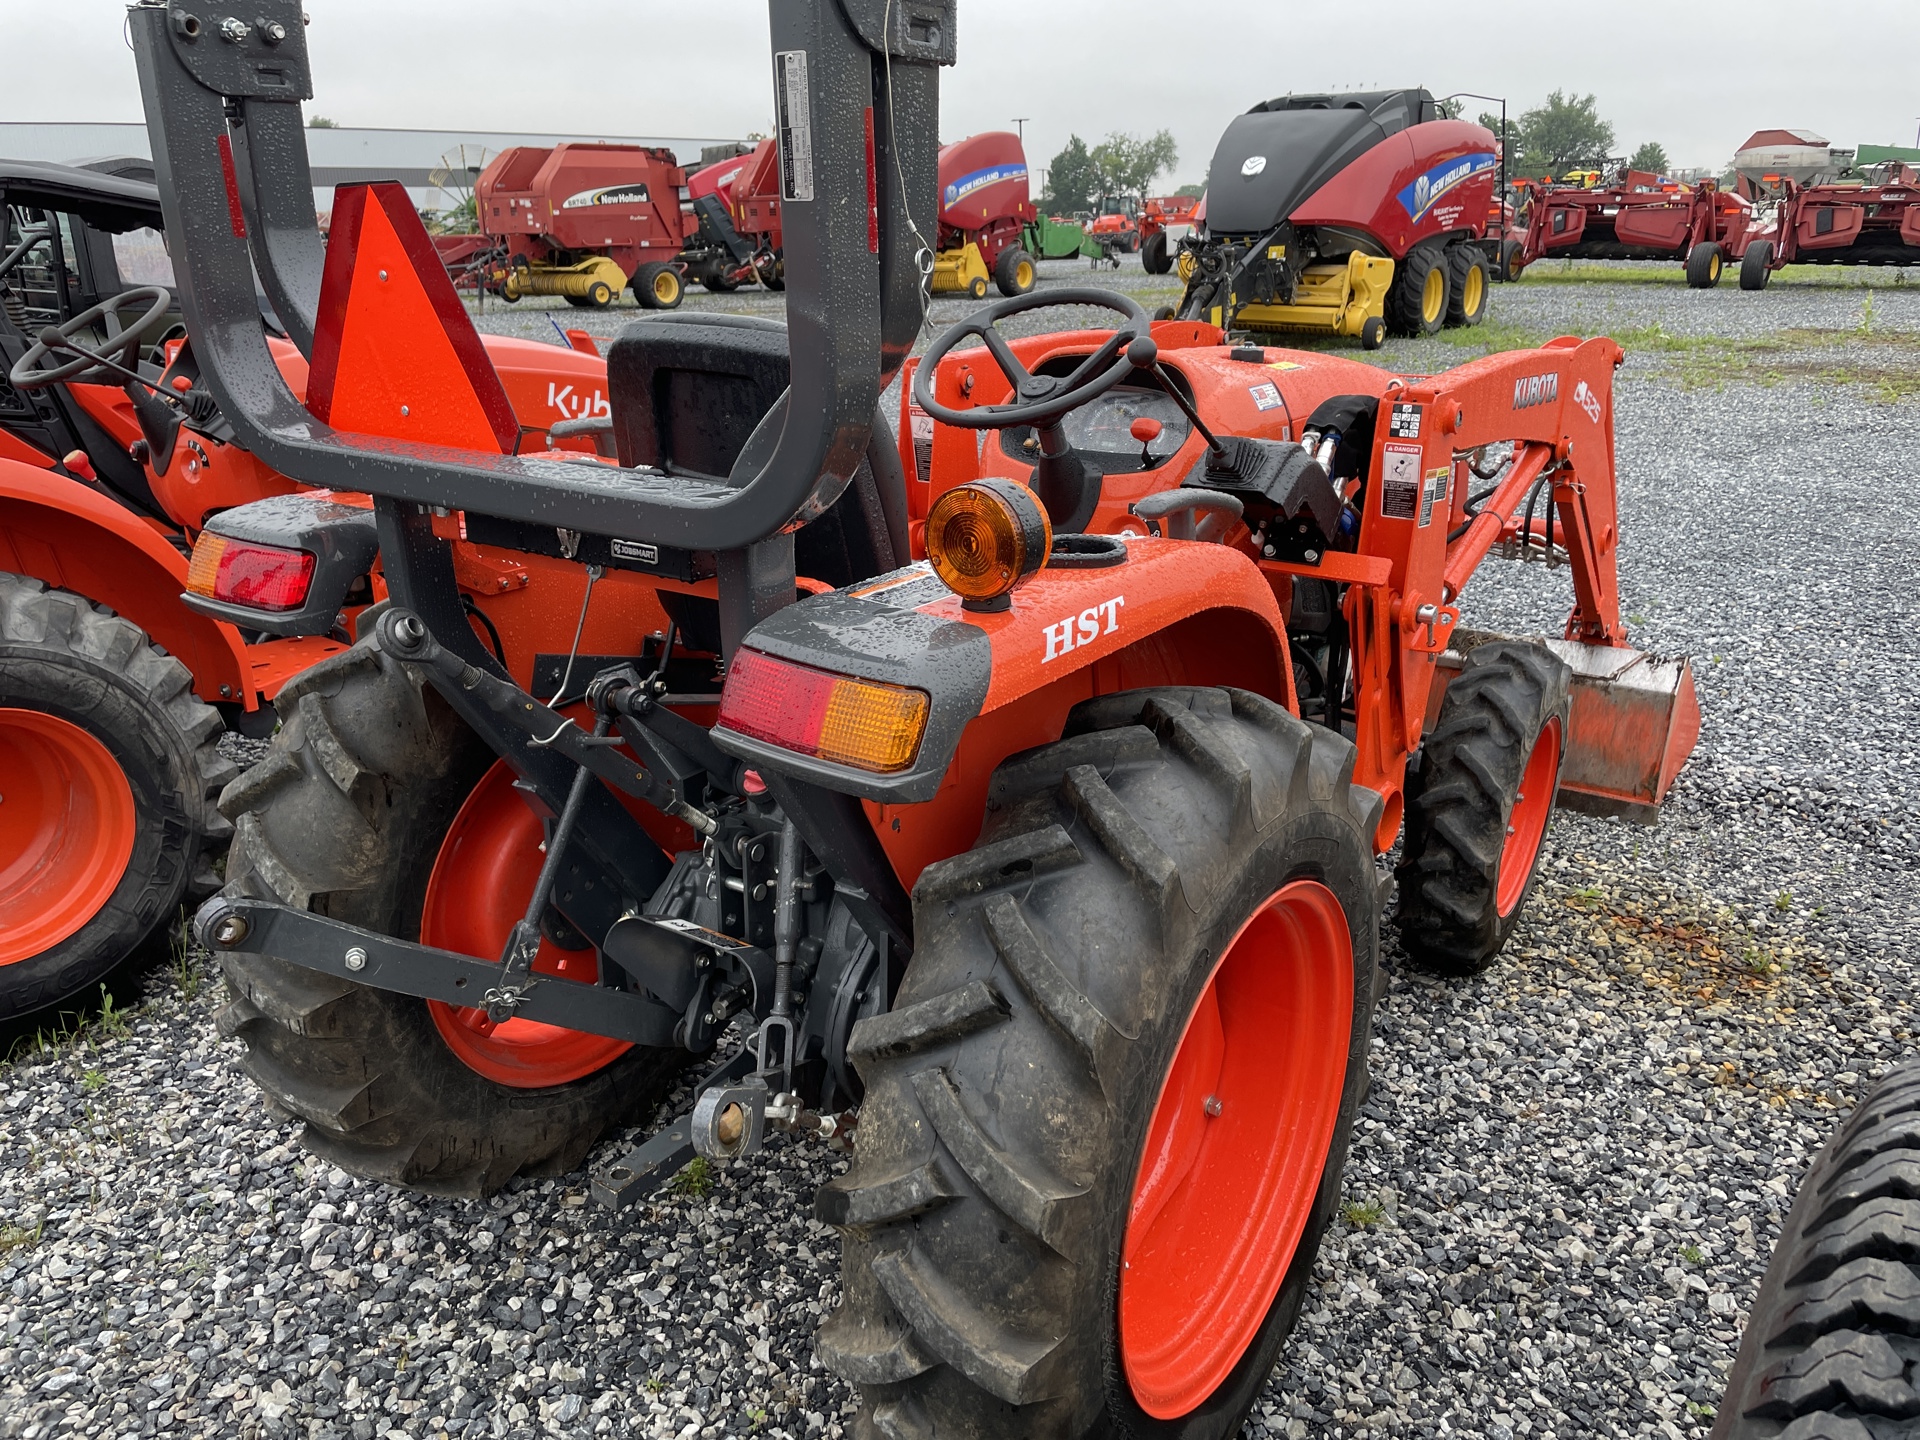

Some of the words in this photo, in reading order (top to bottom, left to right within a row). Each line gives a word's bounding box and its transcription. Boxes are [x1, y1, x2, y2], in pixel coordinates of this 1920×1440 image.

[958, 181, 973, 195] NEW
[973, 171, 999, 188] HOLLAND
[1429, 176, 1446, 198] NEW
[1445, 162, 1471, 186] HOLLAND
[601, 194, 618, 205] New
[618, 192, 647, 203] Holland
[1512, 371, 1558, 411] KUBOTA
[1041, 595, 1125, 665] HST
